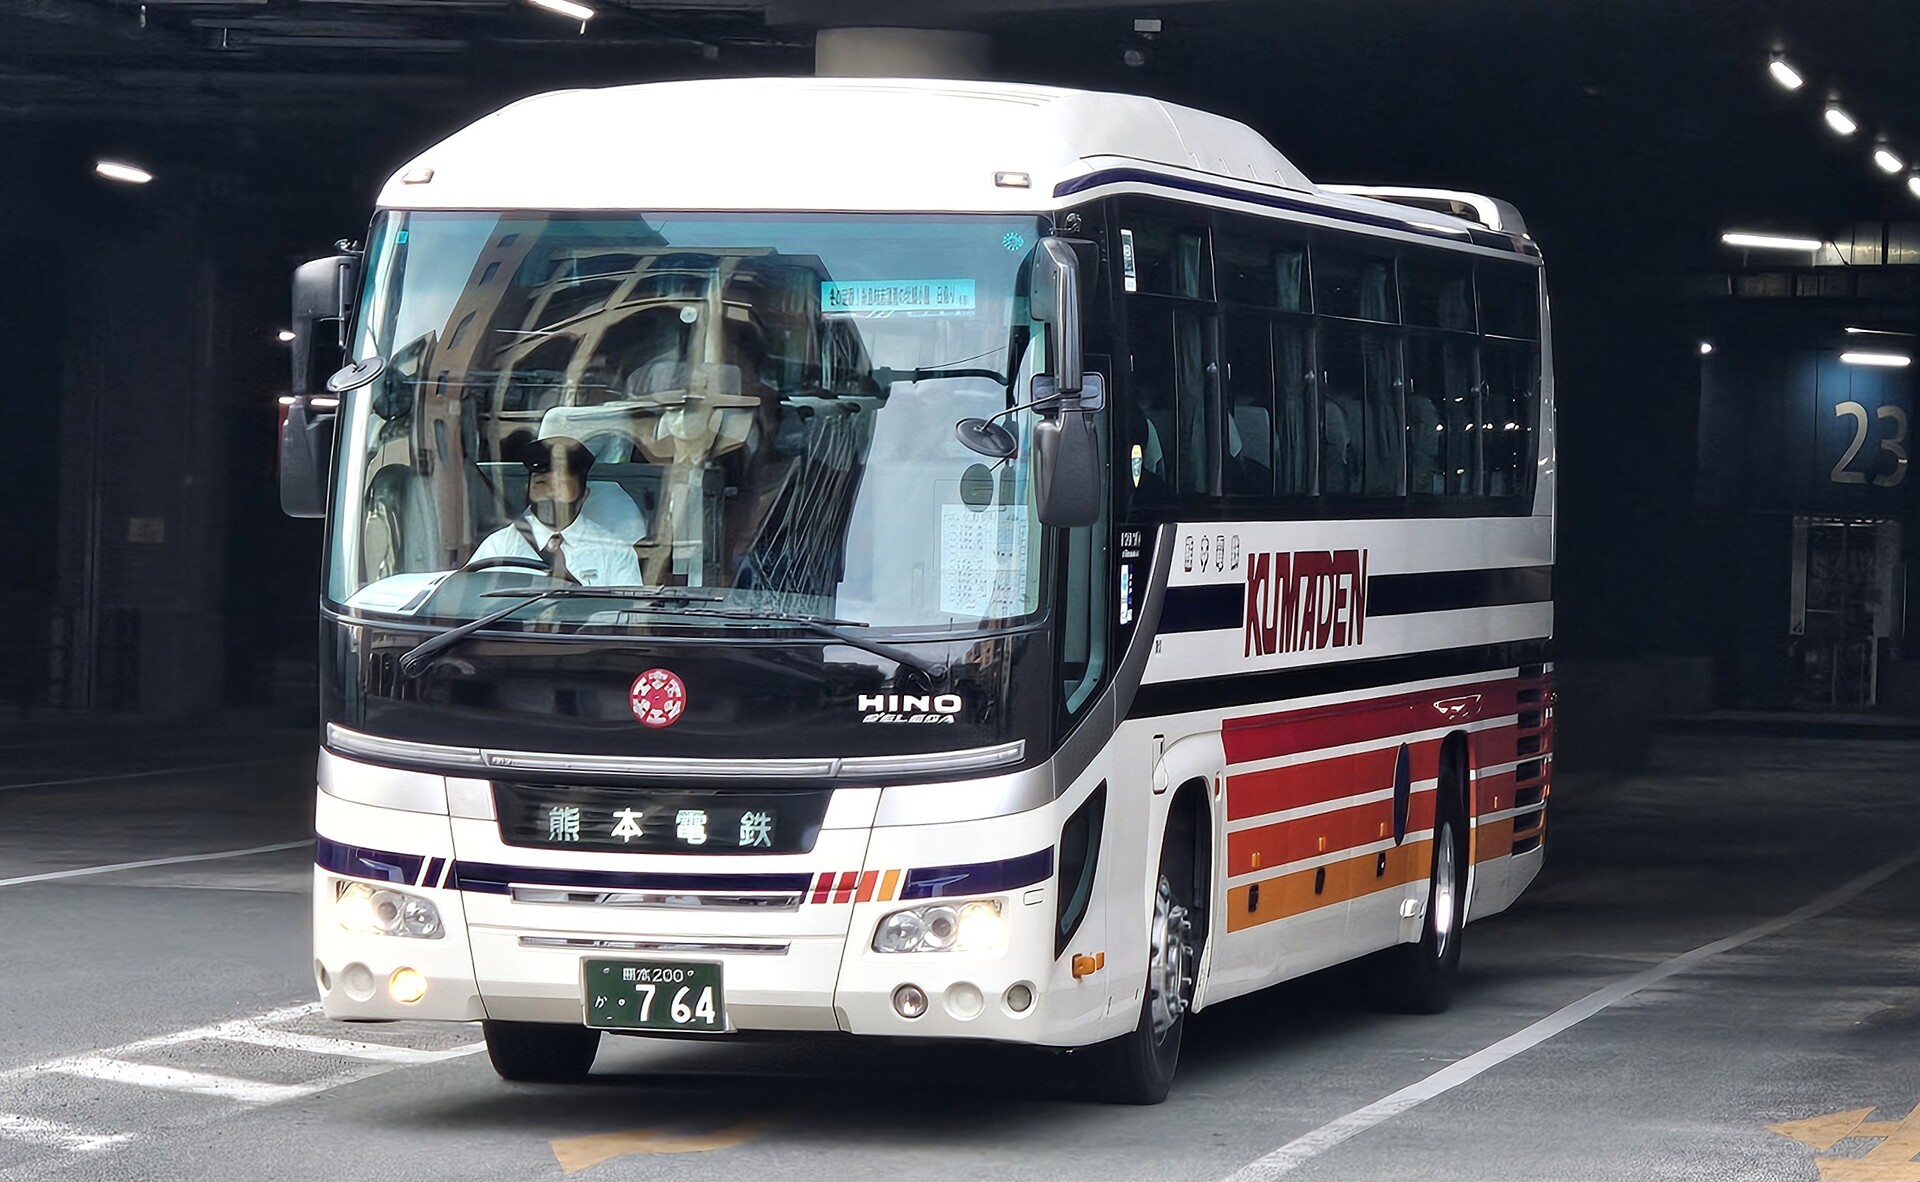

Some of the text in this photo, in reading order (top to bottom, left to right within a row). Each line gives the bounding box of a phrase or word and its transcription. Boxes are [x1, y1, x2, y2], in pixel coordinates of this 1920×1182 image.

[1831, 401, 1908, 487] 23
[1244, 549, 1368, 658] KUMADEN
[858, 694, 962, 713] HINO
[548, 806, 772, 848] 熊本電鉄
